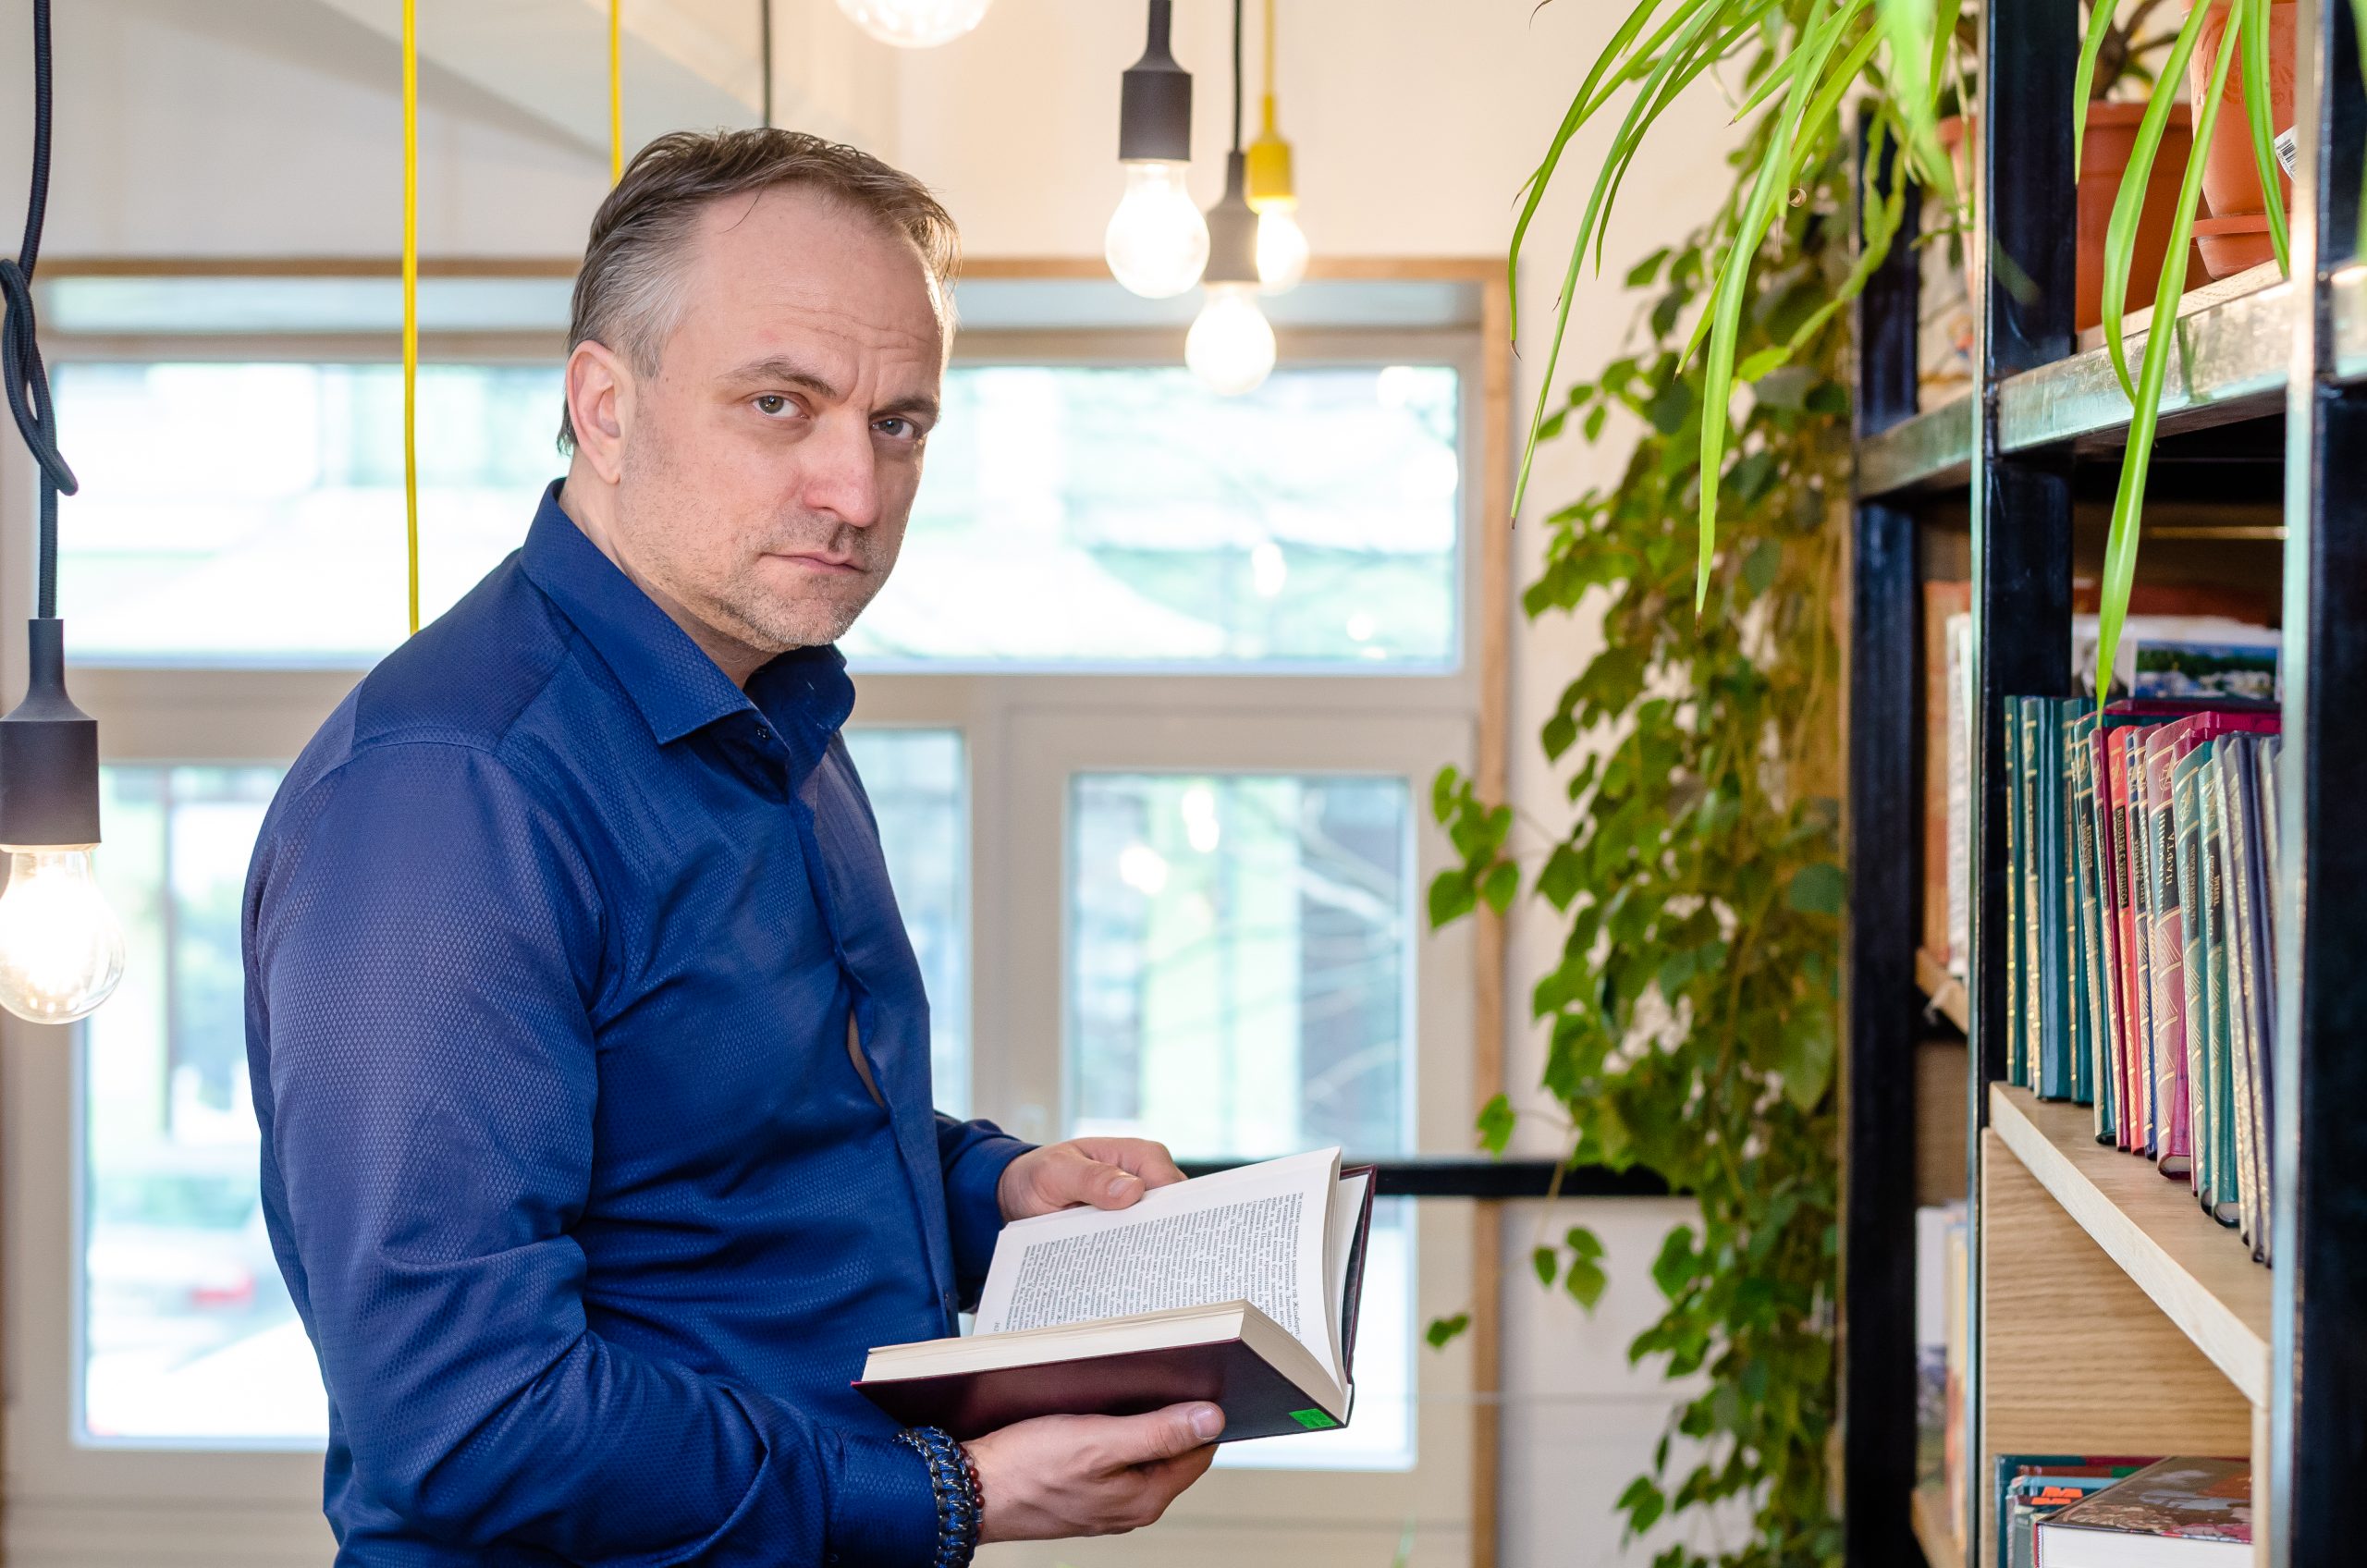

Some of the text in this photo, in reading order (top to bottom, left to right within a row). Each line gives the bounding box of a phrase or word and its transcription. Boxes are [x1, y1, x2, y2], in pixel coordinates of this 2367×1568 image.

[2117, 807, 2125, 851] МЕТОДОМ
[2166, 831, 2174, 884] НАФТА
[2119, 859, 2128, 904] РОЗПРАВА
